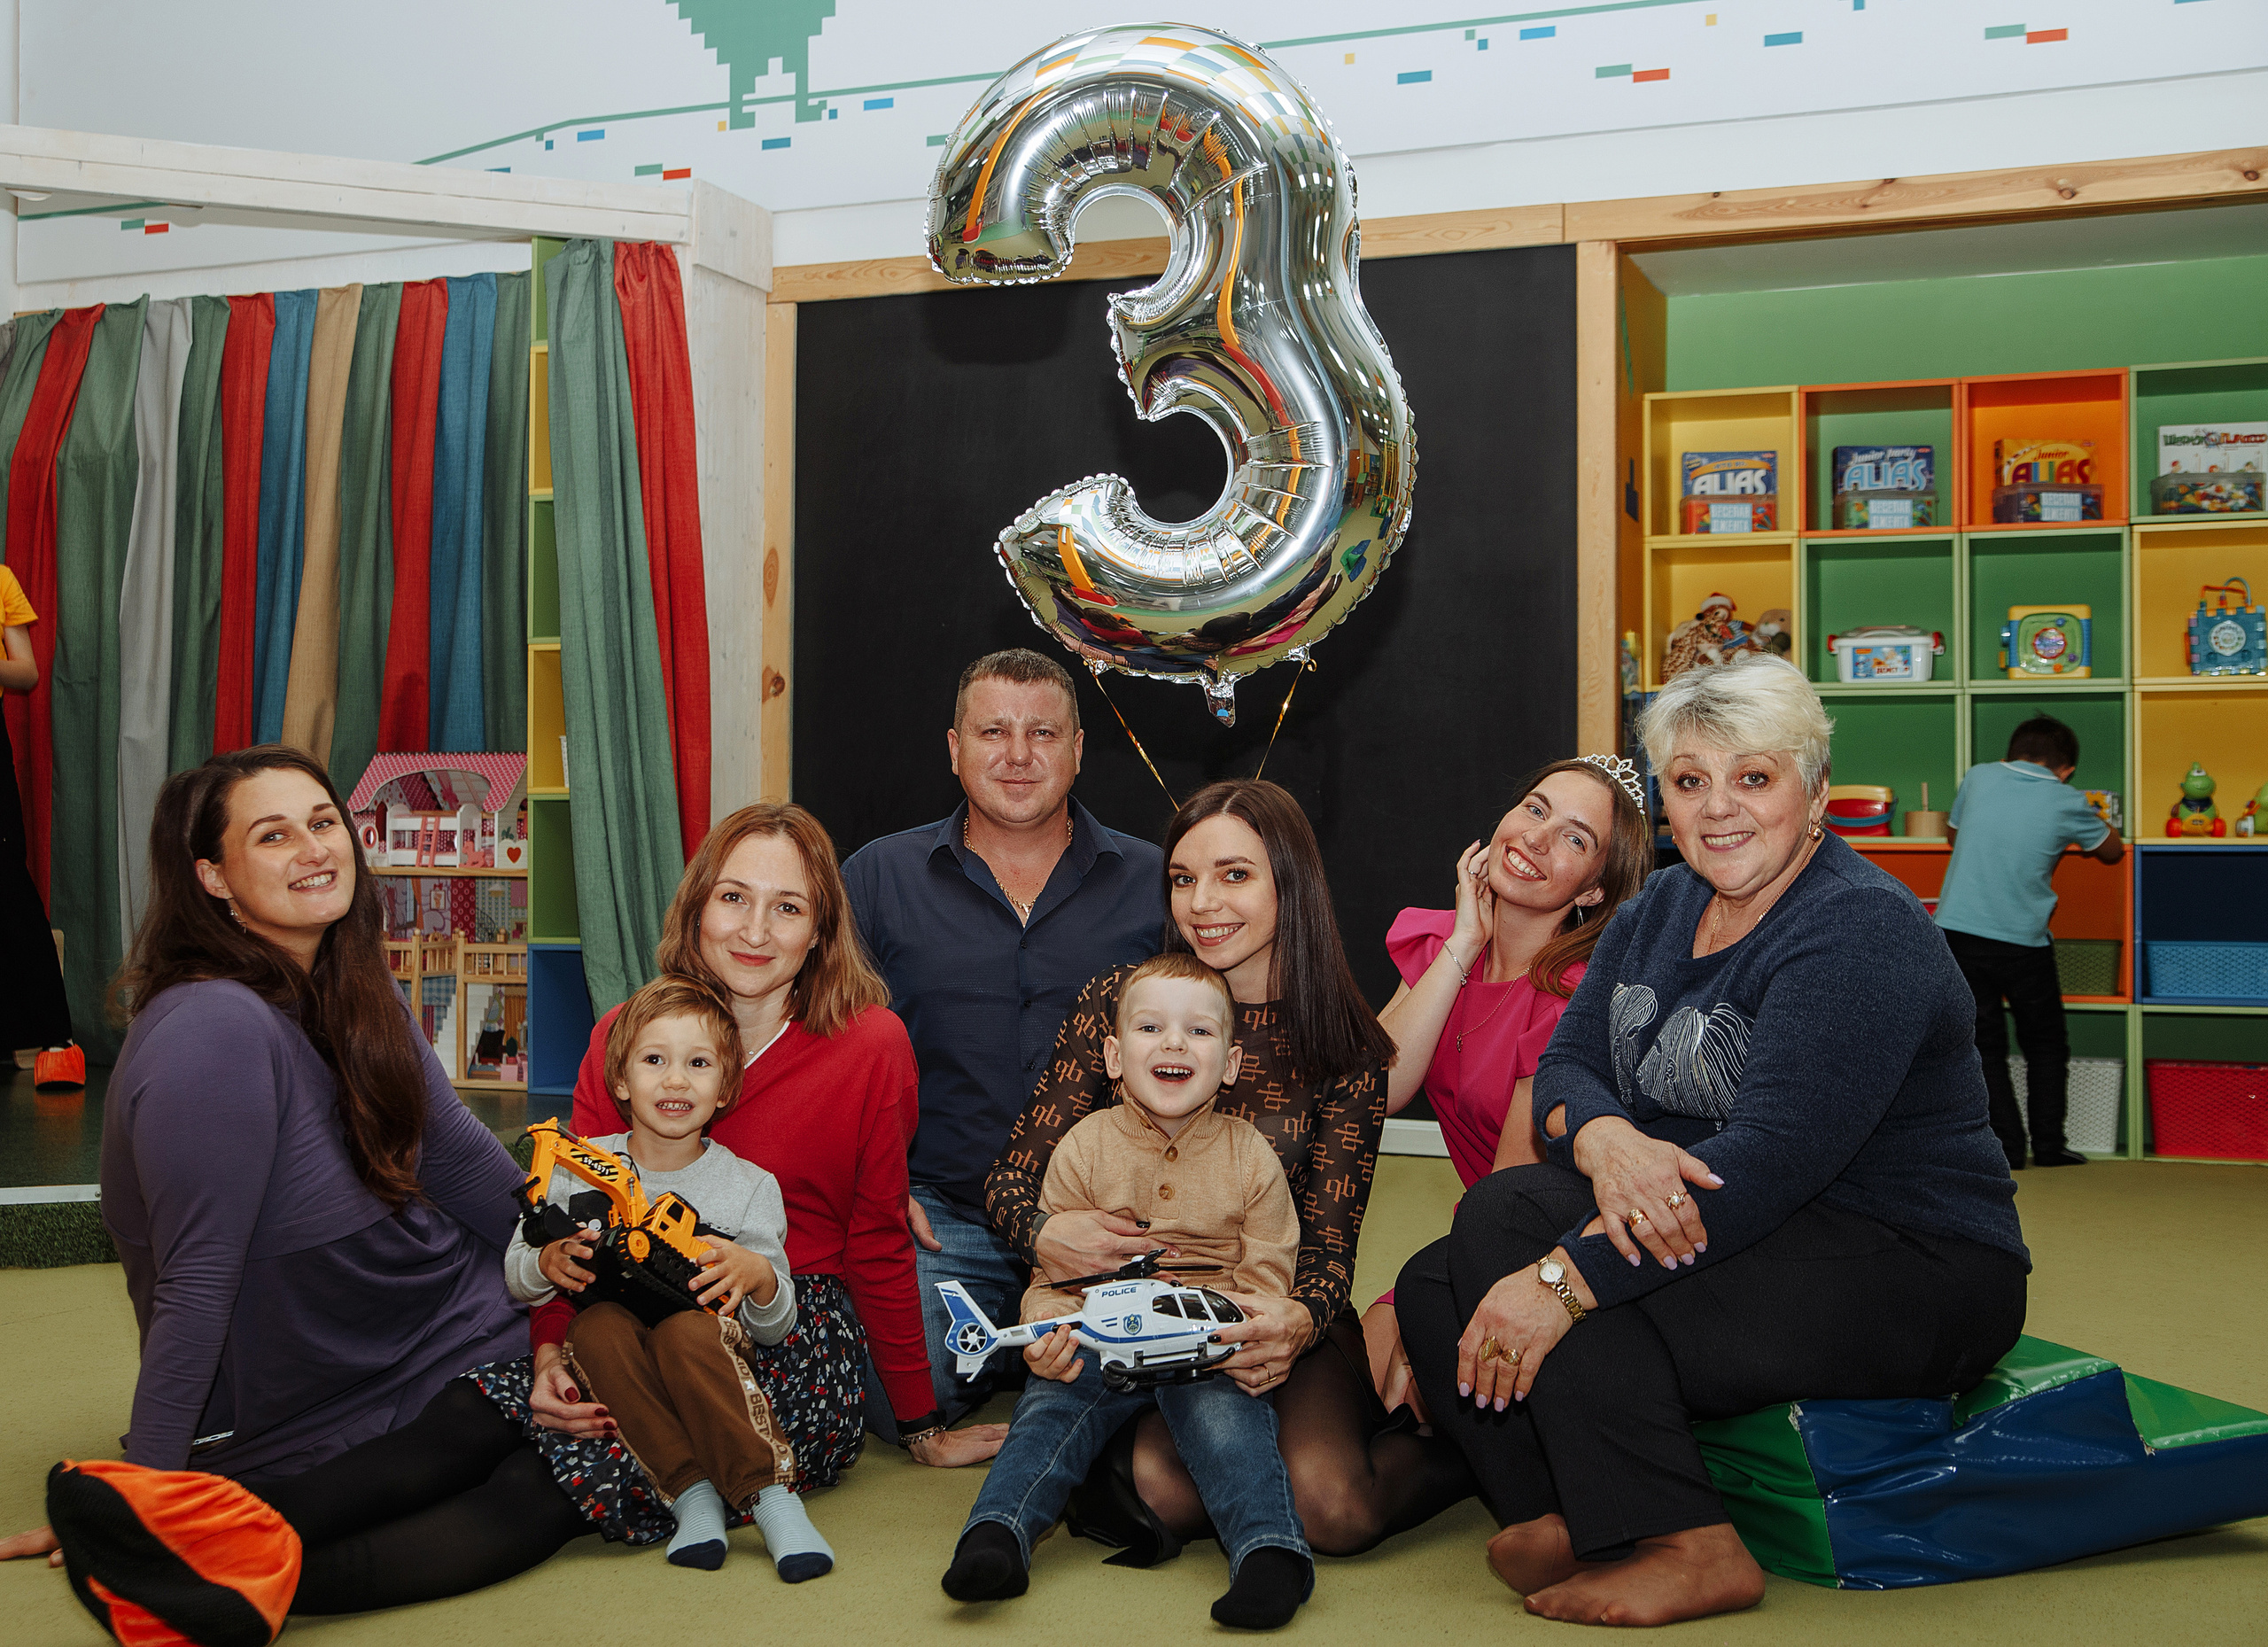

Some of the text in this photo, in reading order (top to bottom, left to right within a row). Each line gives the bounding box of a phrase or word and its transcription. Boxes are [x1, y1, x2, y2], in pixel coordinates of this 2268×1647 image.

[924, 22, 1418, 687] 3
[1693, 469, 1767, 495] ALIAS
[1844, 459, 1927, 492] ALIAS
[2011, 458, 2092, 484] ALIAS
[1101, 1286, 1137, 1298] POLICE
[750, 1393, 770, 1435] BEST
